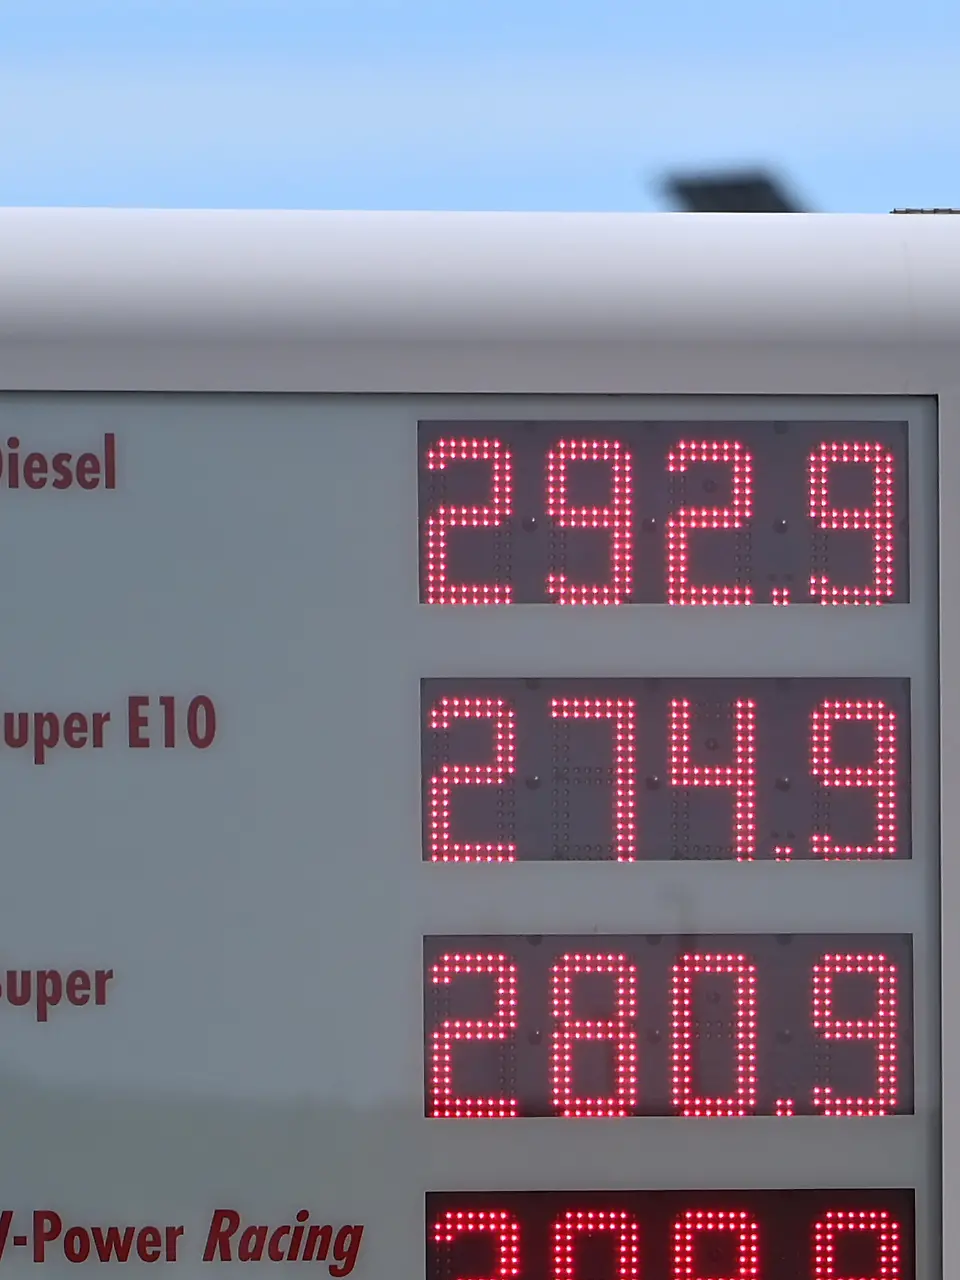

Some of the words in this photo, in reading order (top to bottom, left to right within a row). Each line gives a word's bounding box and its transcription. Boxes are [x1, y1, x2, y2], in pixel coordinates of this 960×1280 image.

[0, 433, 117, 490] iesel
[427, 439, 896, 606] 292.9
[128, 695, 217, 749] E10
[429, 697, 898, 862] 274.9
[0, 968, 114, 1022] uper
[429, 952, 899, 1120] 280.9
[205, 1210, 364, 1278] Racing
